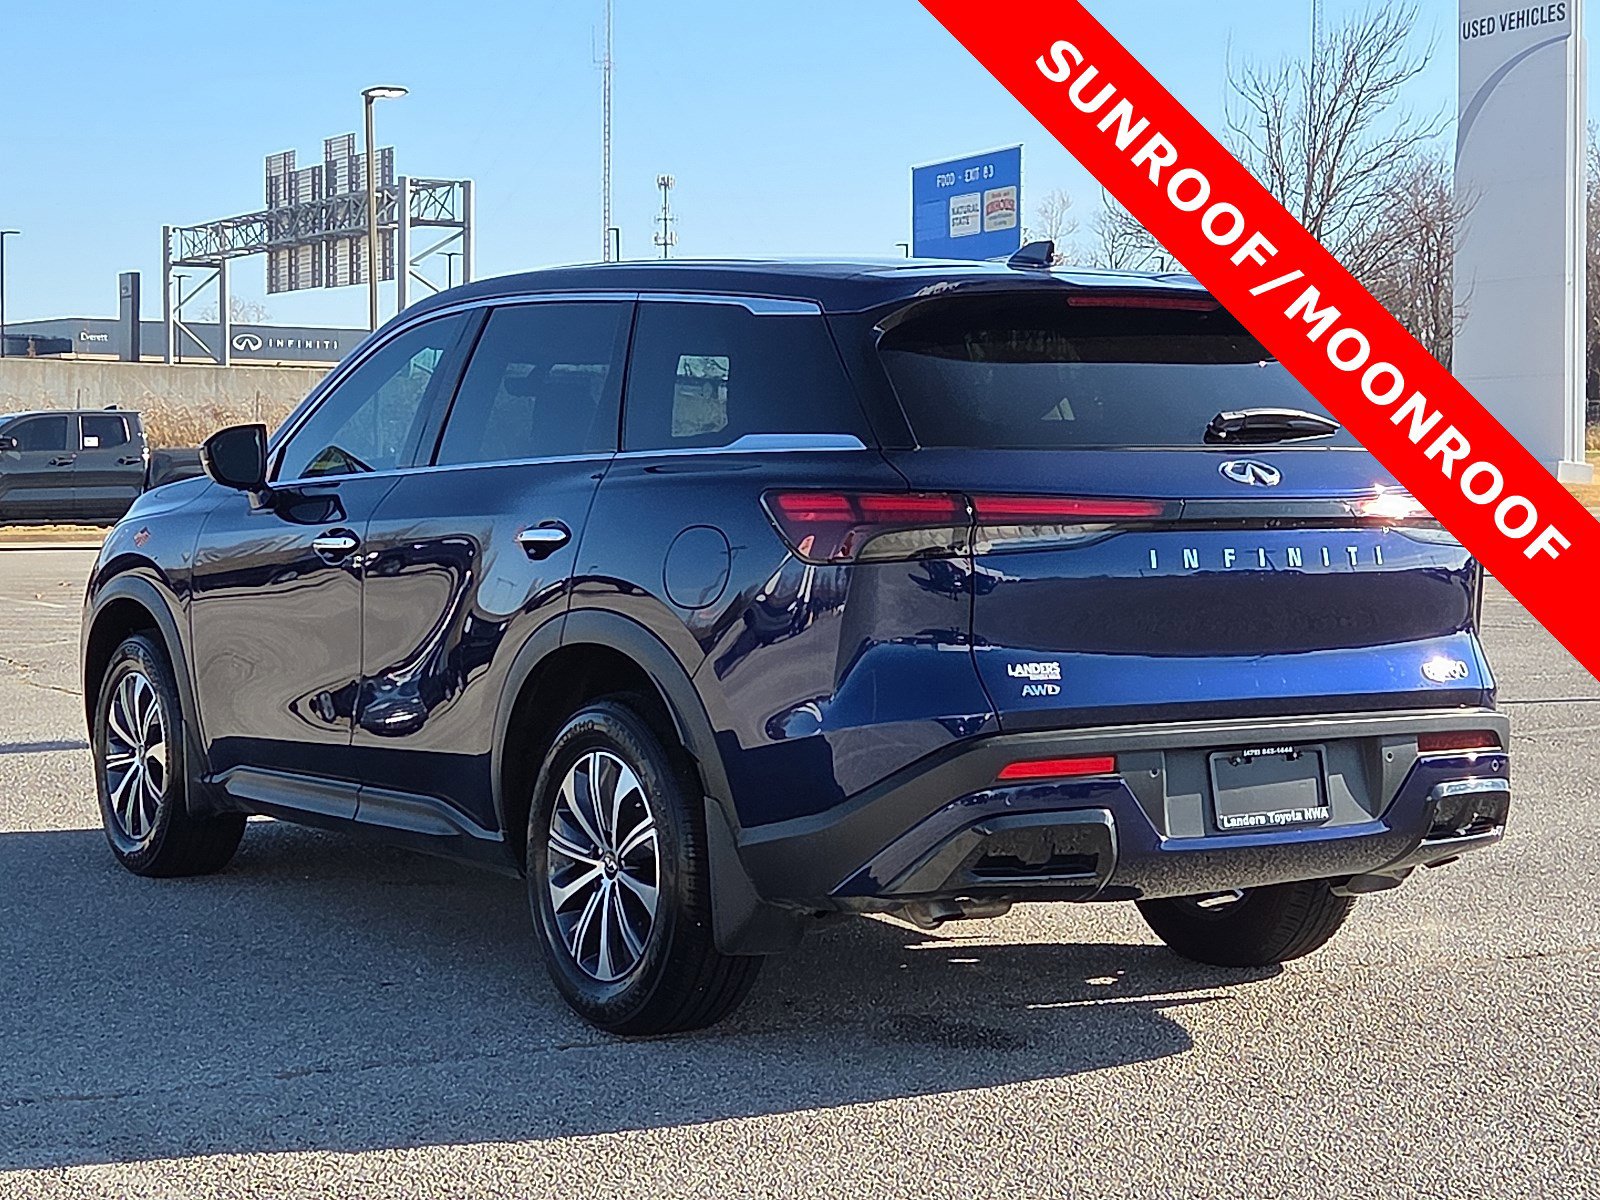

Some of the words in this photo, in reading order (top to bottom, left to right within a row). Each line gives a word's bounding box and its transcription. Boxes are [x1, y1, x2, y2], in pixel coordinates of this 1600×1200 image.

[1462, 16, 1496, 40] USED
[1499, 2, 1566, 32] VEHICLES
[936, 172, 955, 188] FOOD
[80, 332, 108, 341] Everett
[269, 338, 338, 350] INFINITI
[1149, 545, 1384, 569] INFINITI
[1007, 662, 1060, 677] LANDERS
[1022, 684, 1060, 696] AWD
[1223, 814, 1266, 828] Landers
[1267, 810, 1302, 825] Toyota
[1304, 807, 1329, 820] NWA
